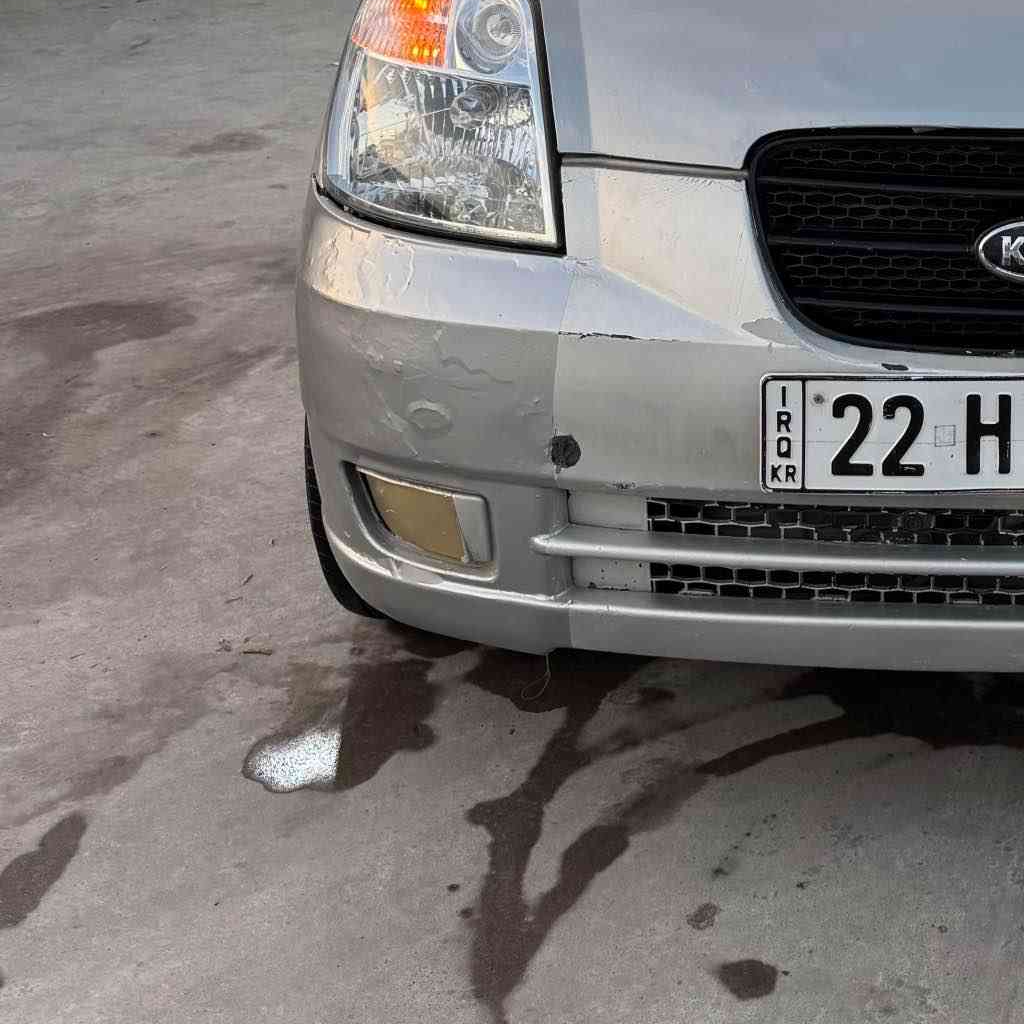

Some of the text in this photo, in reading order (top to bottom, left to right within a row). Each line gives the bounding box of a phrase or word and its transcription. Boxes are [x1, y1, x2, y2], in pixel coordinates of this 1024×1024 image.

[830, 393, 926, 476] 22
[965, 393, 1012, 475] H
[770, 464, 797, 483] KR
